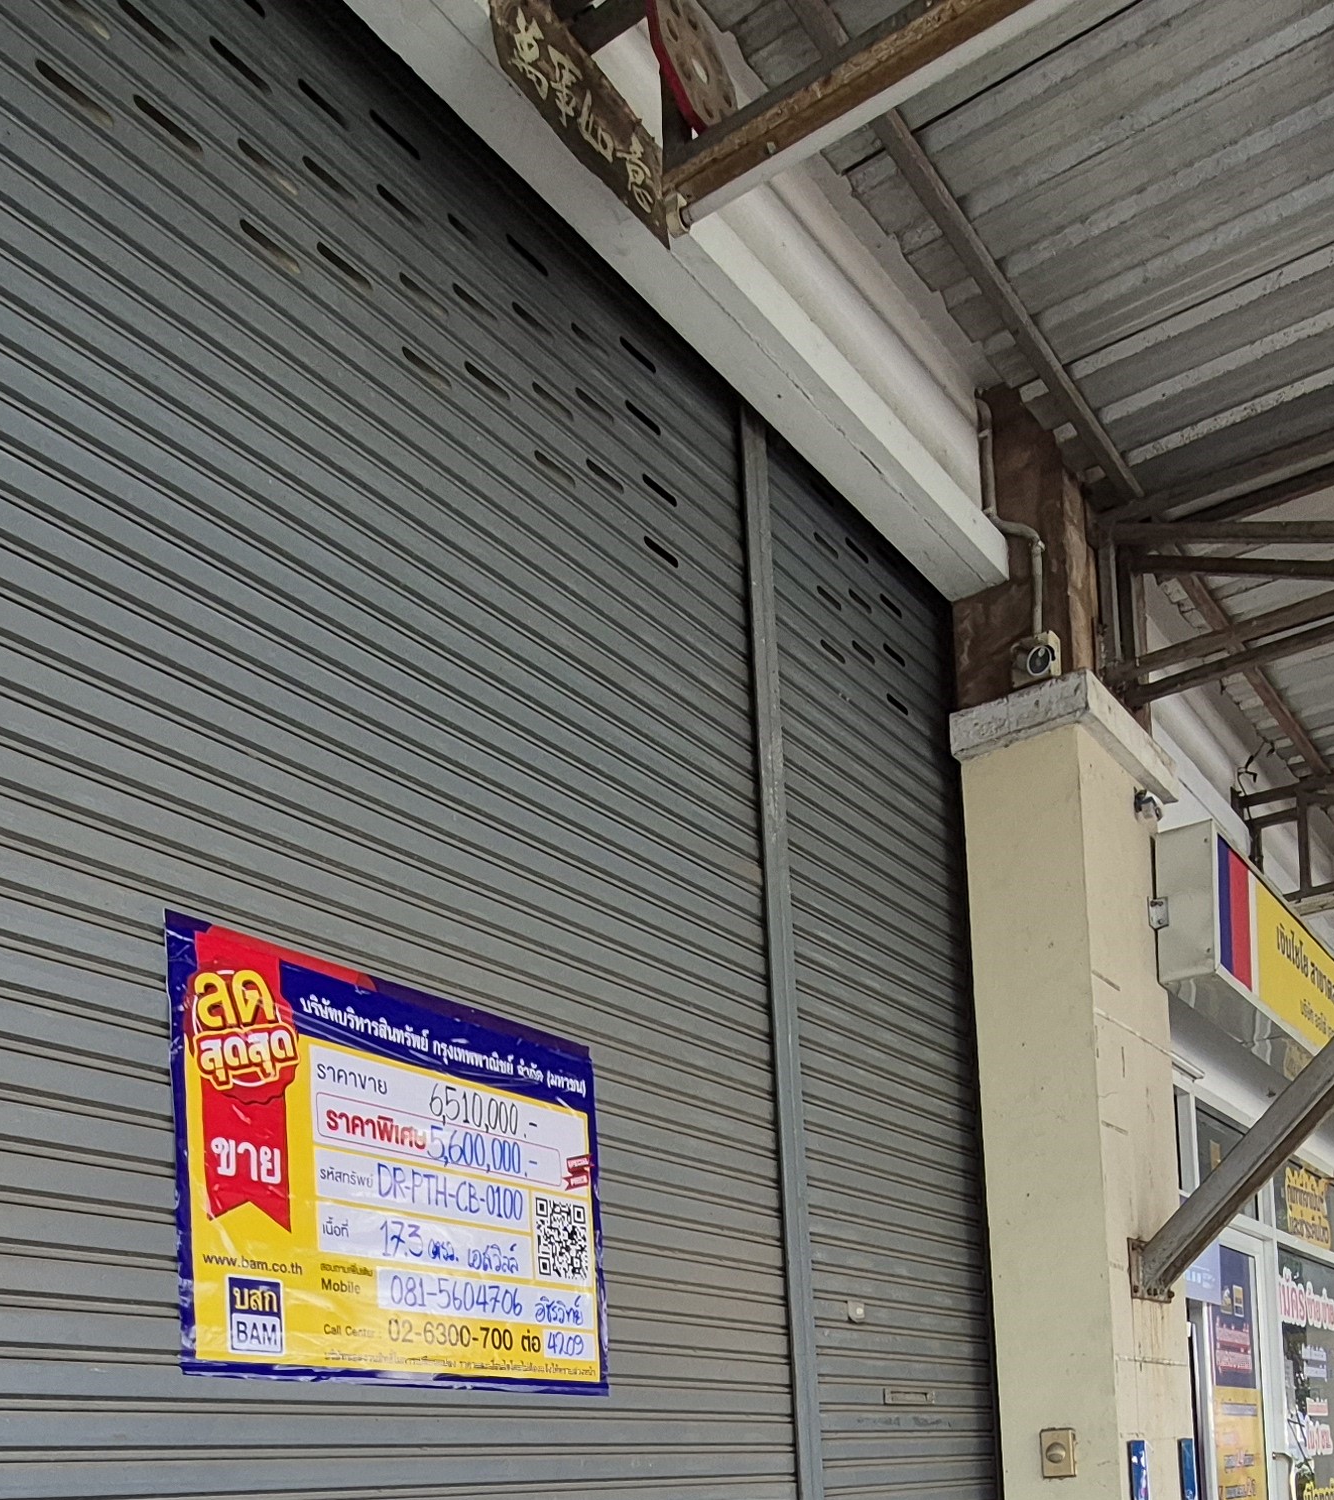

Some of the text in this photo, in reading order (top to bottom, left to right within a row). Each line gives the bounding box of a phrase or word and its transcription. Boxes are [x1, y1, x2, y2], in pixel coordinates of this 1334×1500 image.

[193, 968, 276, 1029] ลด
[198, 1028, 298, 1088] สุดสุด
[299, 994, 587, 1098] บริษัทบริหารสินทรัพย์ กรุงเทพพาณิชย์ จำกัด (มหาชน)
[316, 1062, 388, 1095] ราคาขาย
[325, 1108, 428, 1150] ราคาพิเศษ
[210, 1135, 282, 1184] ขาย
[319, 1162, 523, 1222] รหัสทรัพย์ DR-PTH-CB-0100
[322, 1216, 350, 1239] เนื้อที่
[202, 1252, 304, 1277] www.bam.co.th
[232, 1285, 279, 1314] บสก
[321, 1277, 362, 1295] Mobile
[390, 1274, 523, 1317] 081-5604706
[235, 1319, 278, 1347] BAM
[323, 1323, 343, 1336] Call
[387, 1318, 514, 1352] 02-6300-700
[520, 1329, 542, 1353] ต่อ
